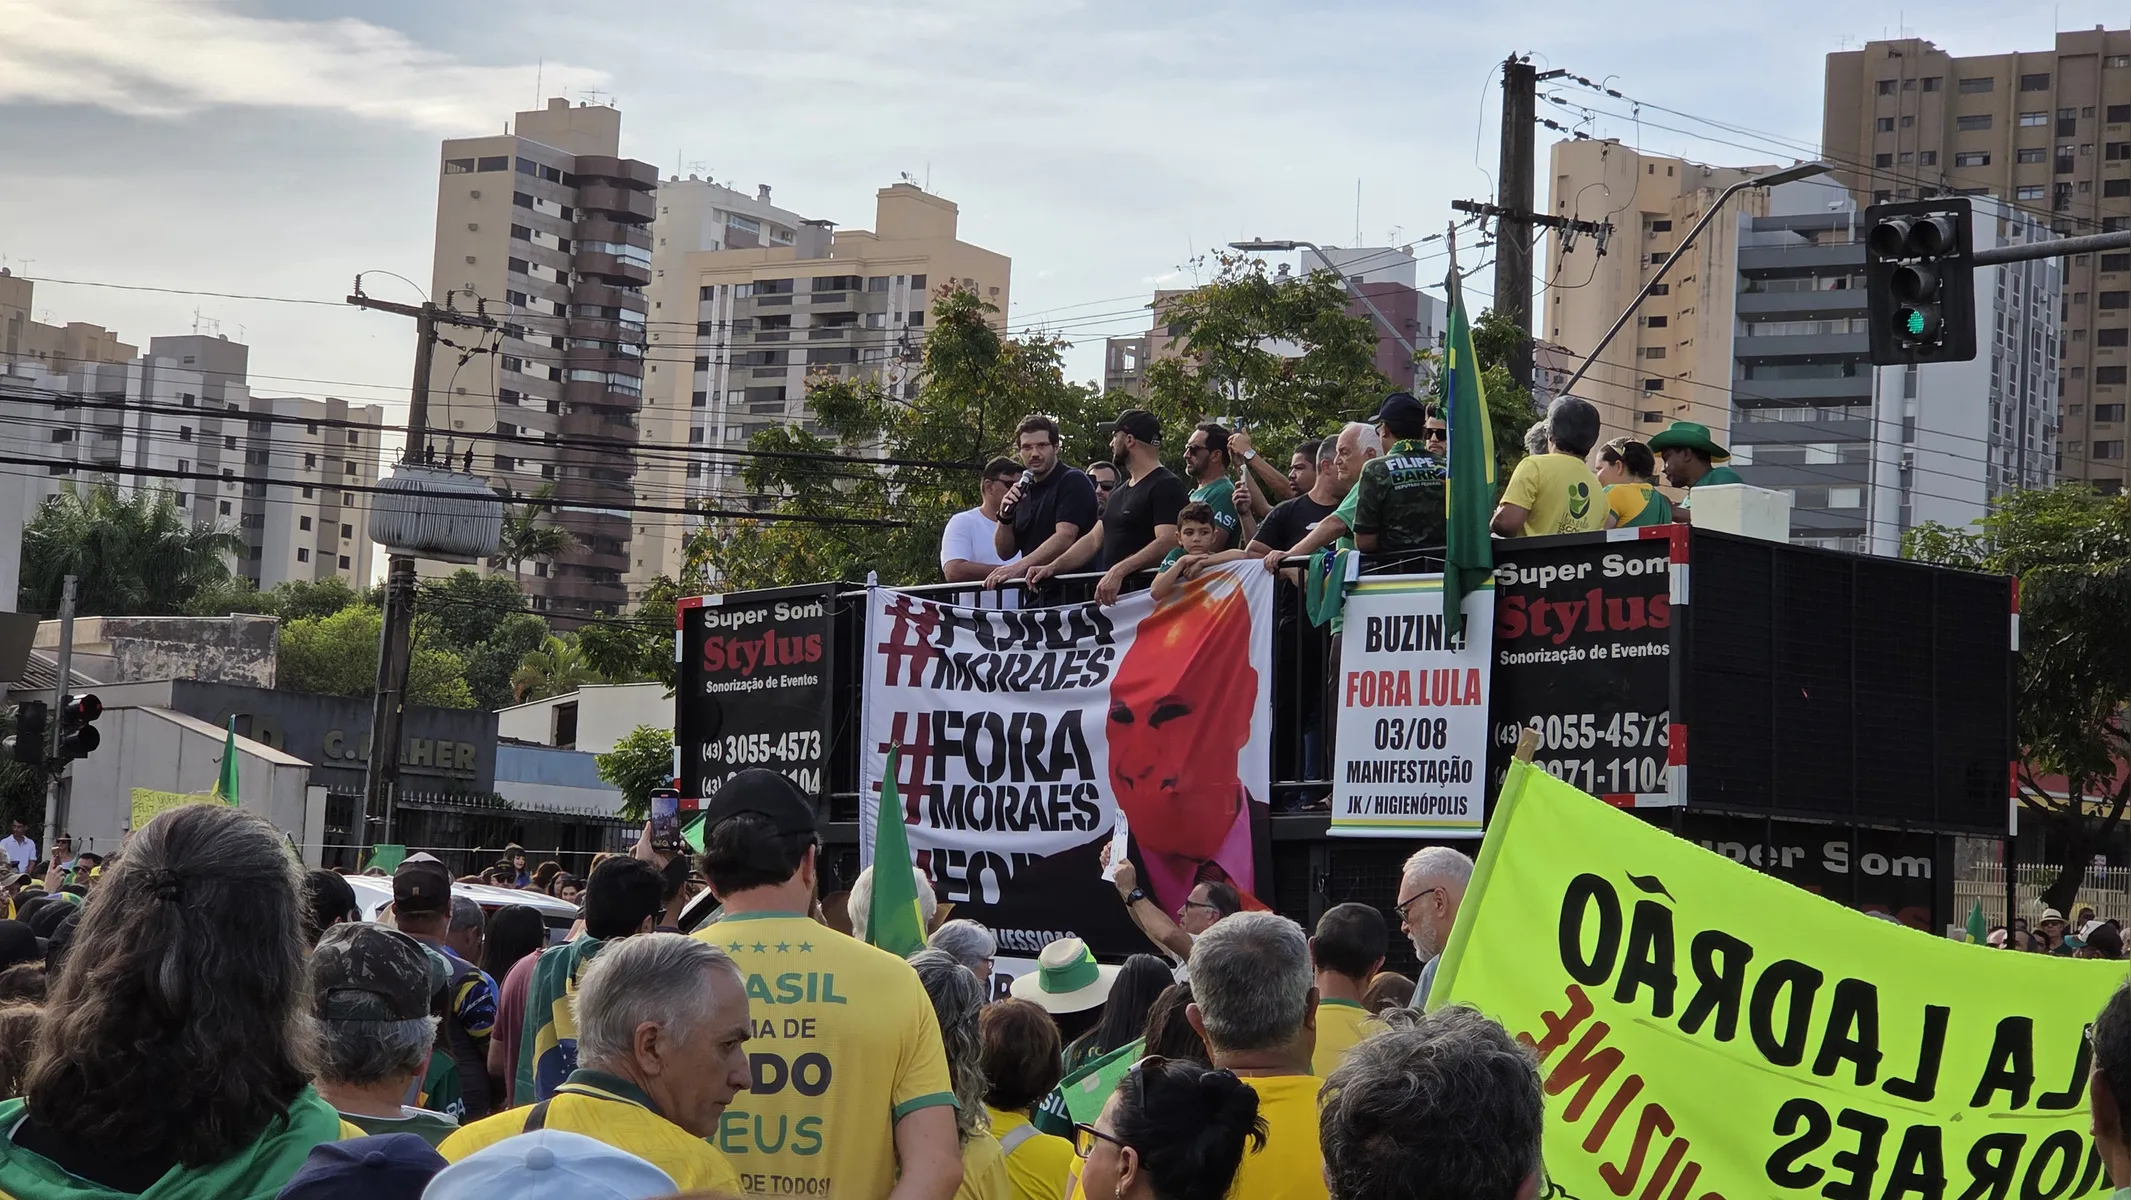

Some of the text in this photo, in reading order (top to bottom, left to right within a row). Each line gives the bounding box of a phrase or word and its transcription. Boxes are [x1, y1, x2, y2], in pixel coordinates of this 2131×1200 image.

[1385, 456, 1435, 471] FILIPE
[1497, 554, 1670, 588] Super Som
[704, 602, 823, 630] Super Som
[1497, 588, 1670, 644] Stylus
[704, 629, 823, 676] Stylus
[932, 647, 1116, 692] MORAES
[1500, 642, 1670, 665] Sonorização de Eventos
[706, 674, 818, 694] Sonorização de Eventos
[1346, 668, 1481, 707] FORA LULA
[702, 730, 821, 764] (43) 3055-4573
[1374, 718, 1448, 750] 03/08
[1530, 710, 1669, 750] 3055-4573
[1346, 756, 1473, 788] MANIFESTAÇÃO
[929, 783, 1100, 831] MORAES
[1347, 793, 1468, 815] JK / HIGIENÓPOLIS
[1701, 840, 1932, 879] per Som
[746, 972, 847, 1004] ASIL
[784, 1018, 816, 1039] DE
[749, 1052, 832, 1096] DO
[711, 1111, 823, 1156] EUS
[740, 1172, 766, 1192] DE
